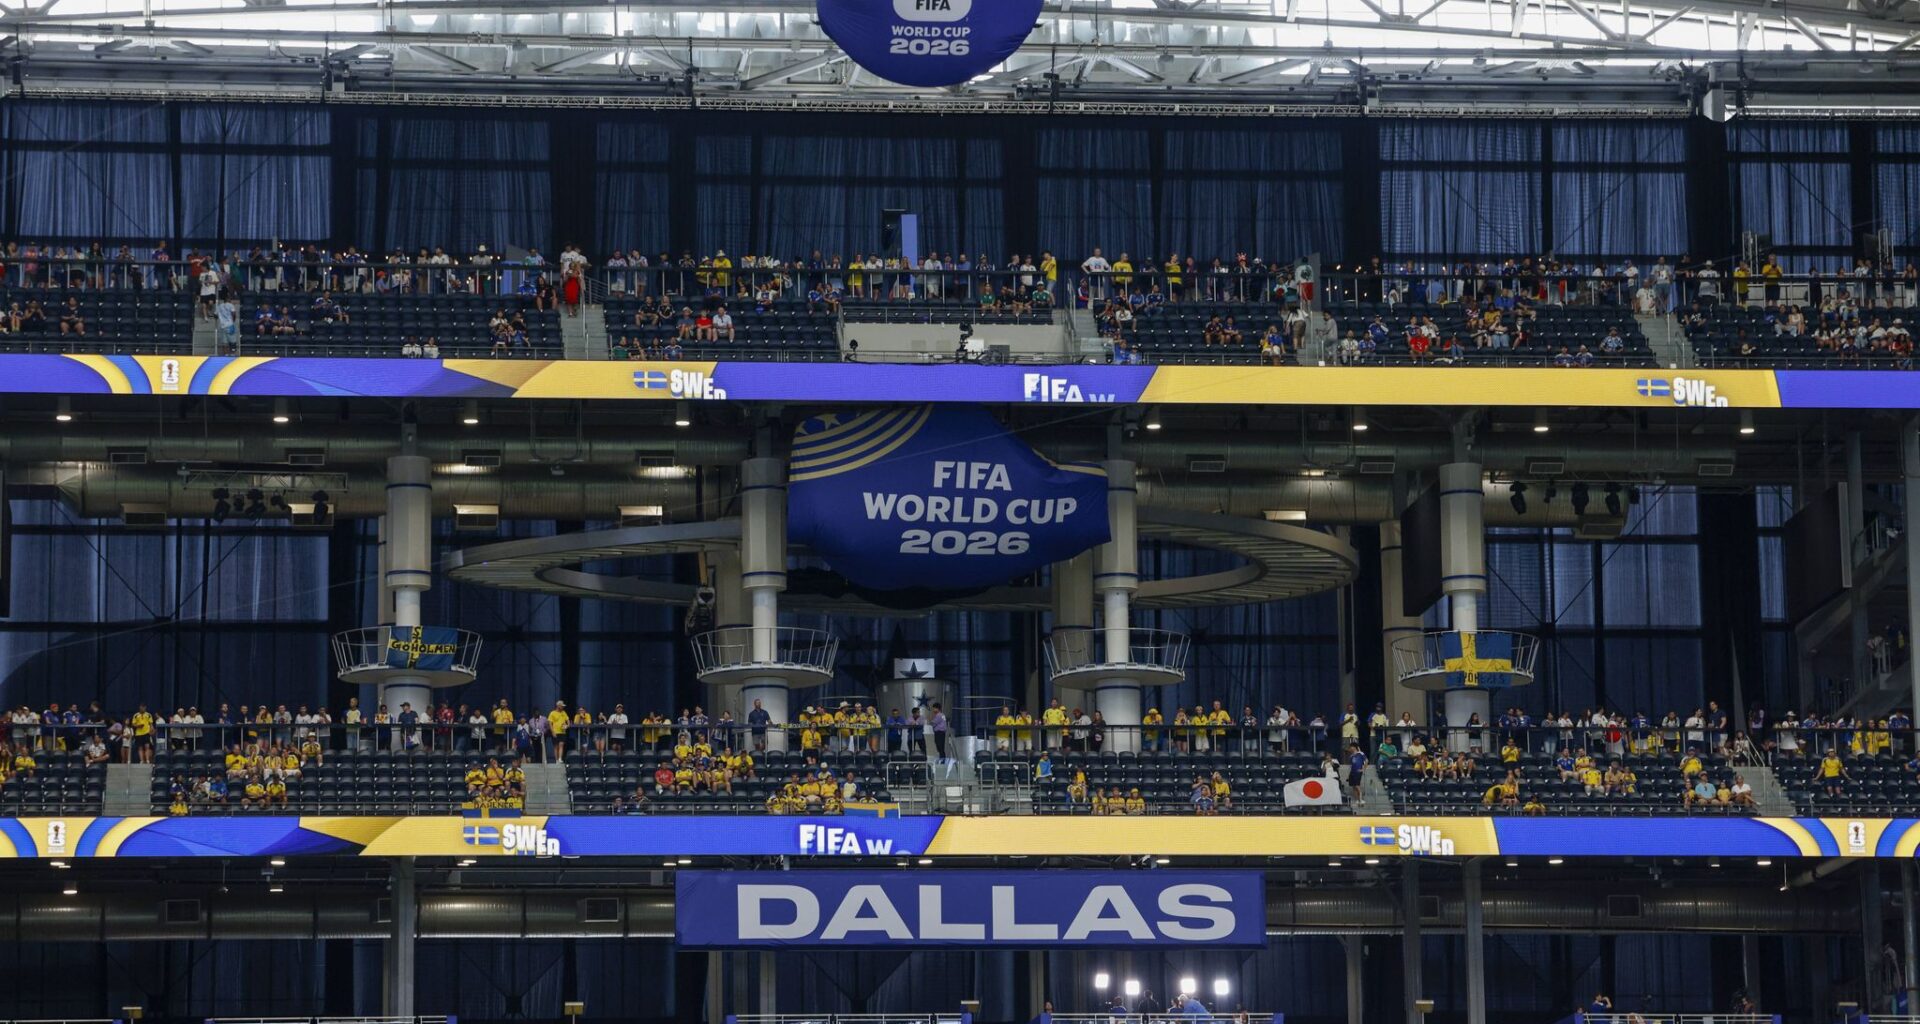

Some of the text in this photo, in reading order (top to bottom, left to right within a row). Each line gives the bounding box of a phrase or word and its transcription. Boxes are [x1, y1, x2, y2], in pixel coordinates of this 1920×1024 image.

[915, 0, 951, 11] FIFA
[891, 25, 971, 38] WORLD CUP
[889, 39, 970, 56] 2026
[1024, 373, 1084, 402] FIFA
[933, 460, 1013, 491] FIFA
[863, 492, 1077, 525] WORLD CUP
[899, 529, 1030, 555] 2026
[799, 824, 862, 855] FIFA
[737, 883, 1237, 941] DALLAS
